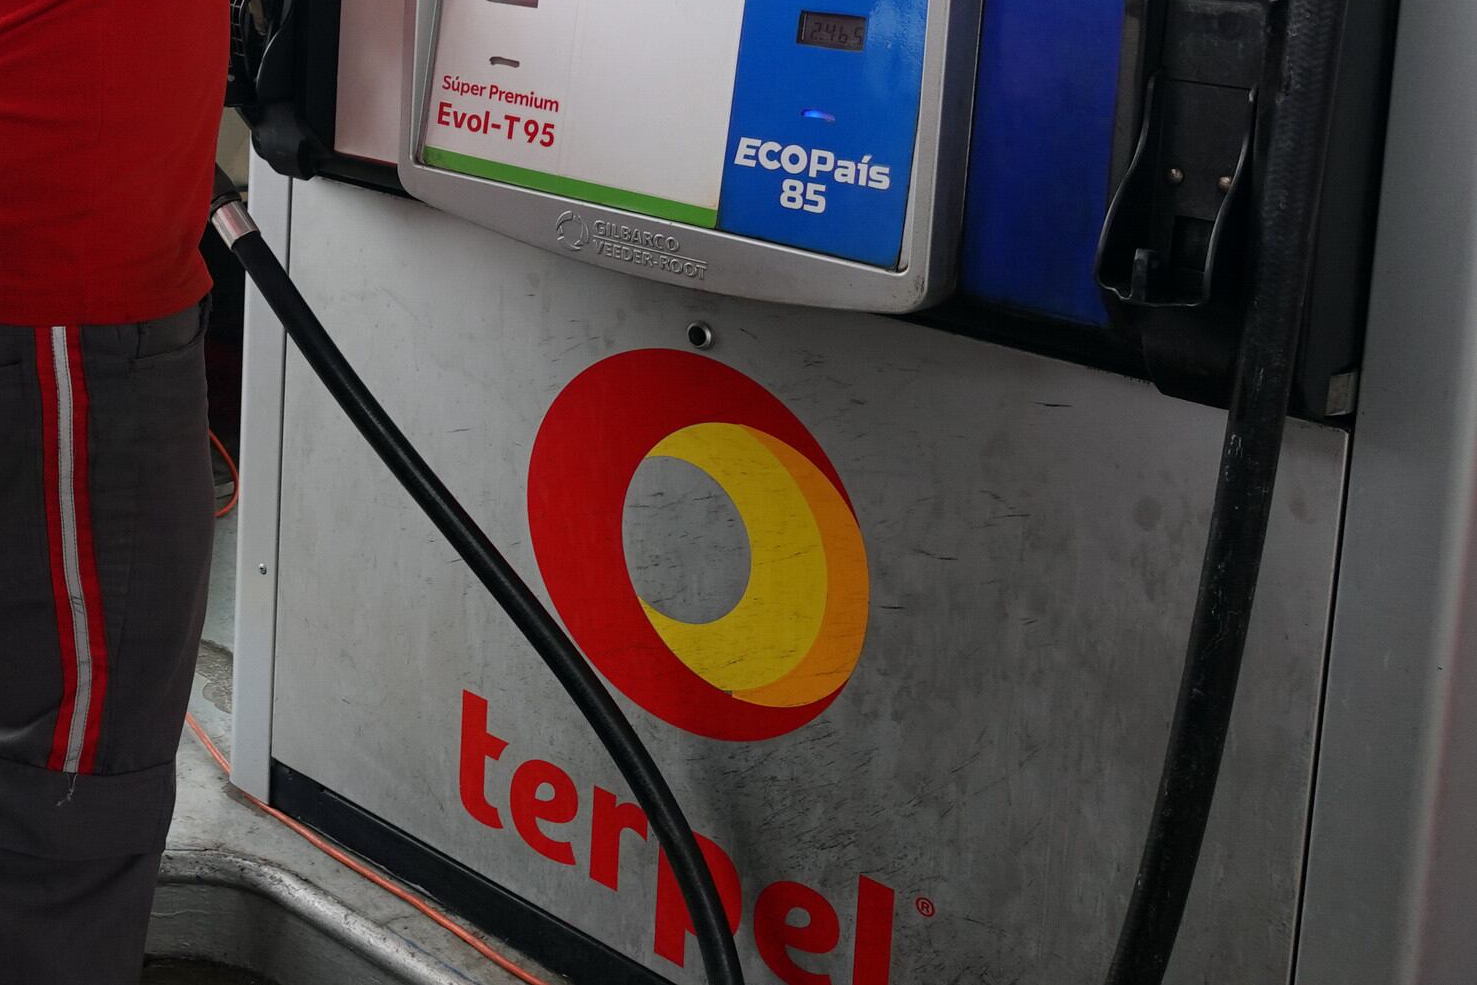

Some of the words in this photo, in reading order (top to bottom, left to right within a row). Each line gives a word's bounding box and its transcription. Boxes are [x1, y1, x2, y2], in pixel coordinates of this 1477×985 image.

[442, 75, 487, 97] Súper
[489, 85, 560, 113] Premium
[734, 137, 891, 190] ECOPaís
[780, 179, 826, 214] 85
[594, 220, 680, 252] GILBARCO
[592, 239, 708, 280] VEEDER-ROOT
[459, 689, 895, 985] terpel
